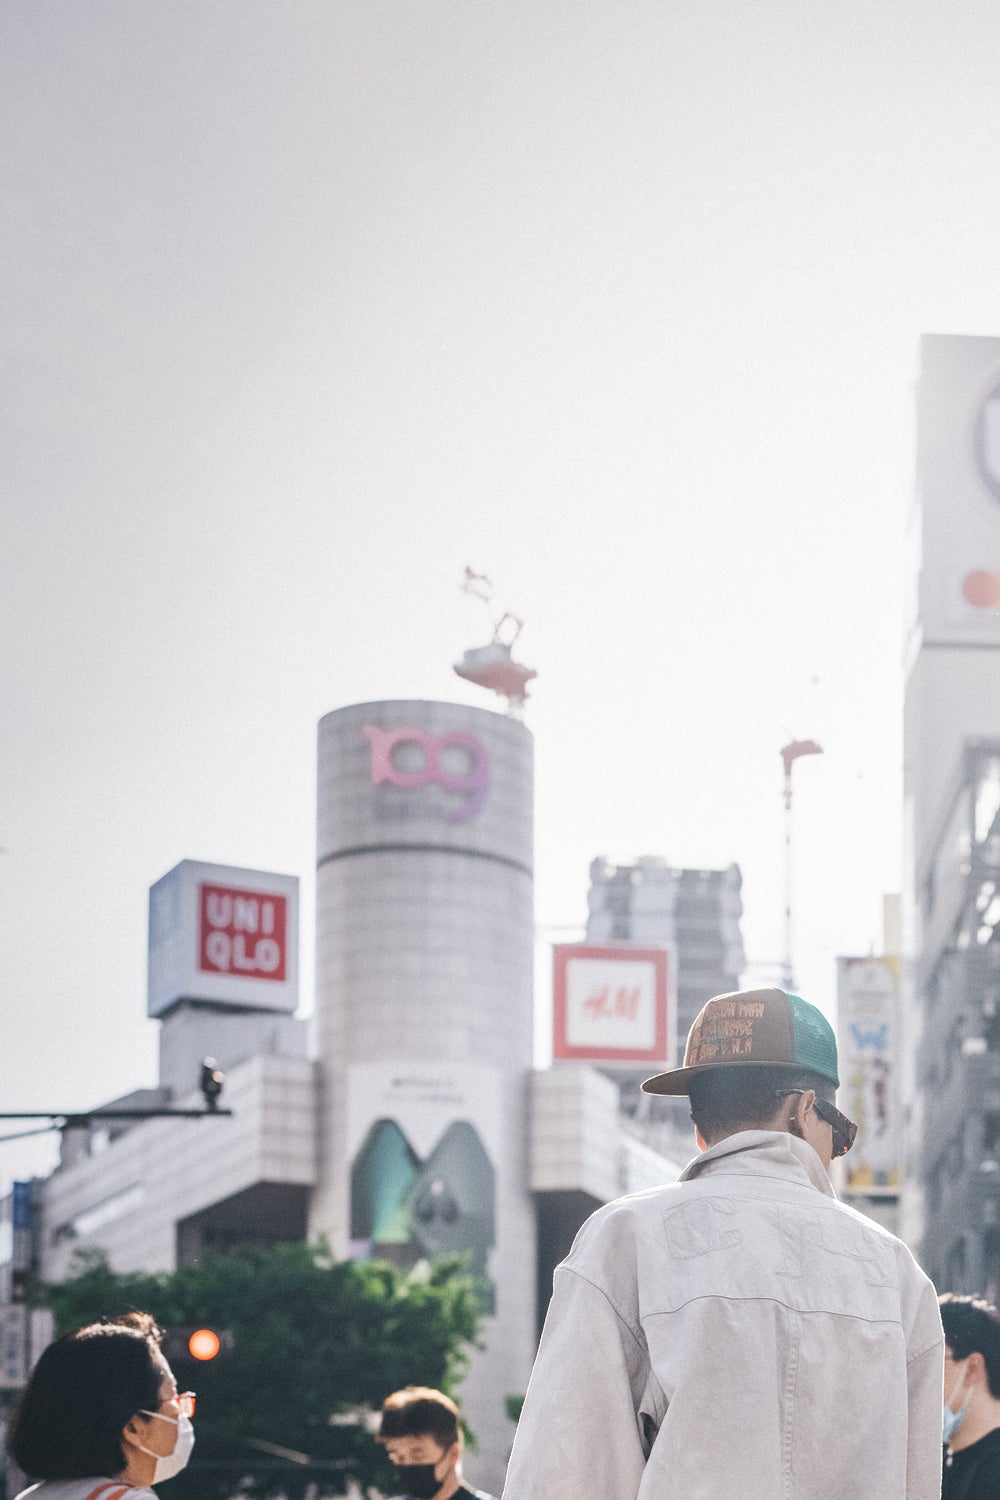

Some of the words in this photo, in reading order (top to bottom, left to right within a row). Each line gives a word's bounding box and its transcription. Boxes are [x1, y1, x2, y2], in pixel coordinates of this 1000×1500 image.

[362, 722, 490, 821] 109
[206, 892, 275, 935] UNI
[206, 931, 281, 973] QLO
